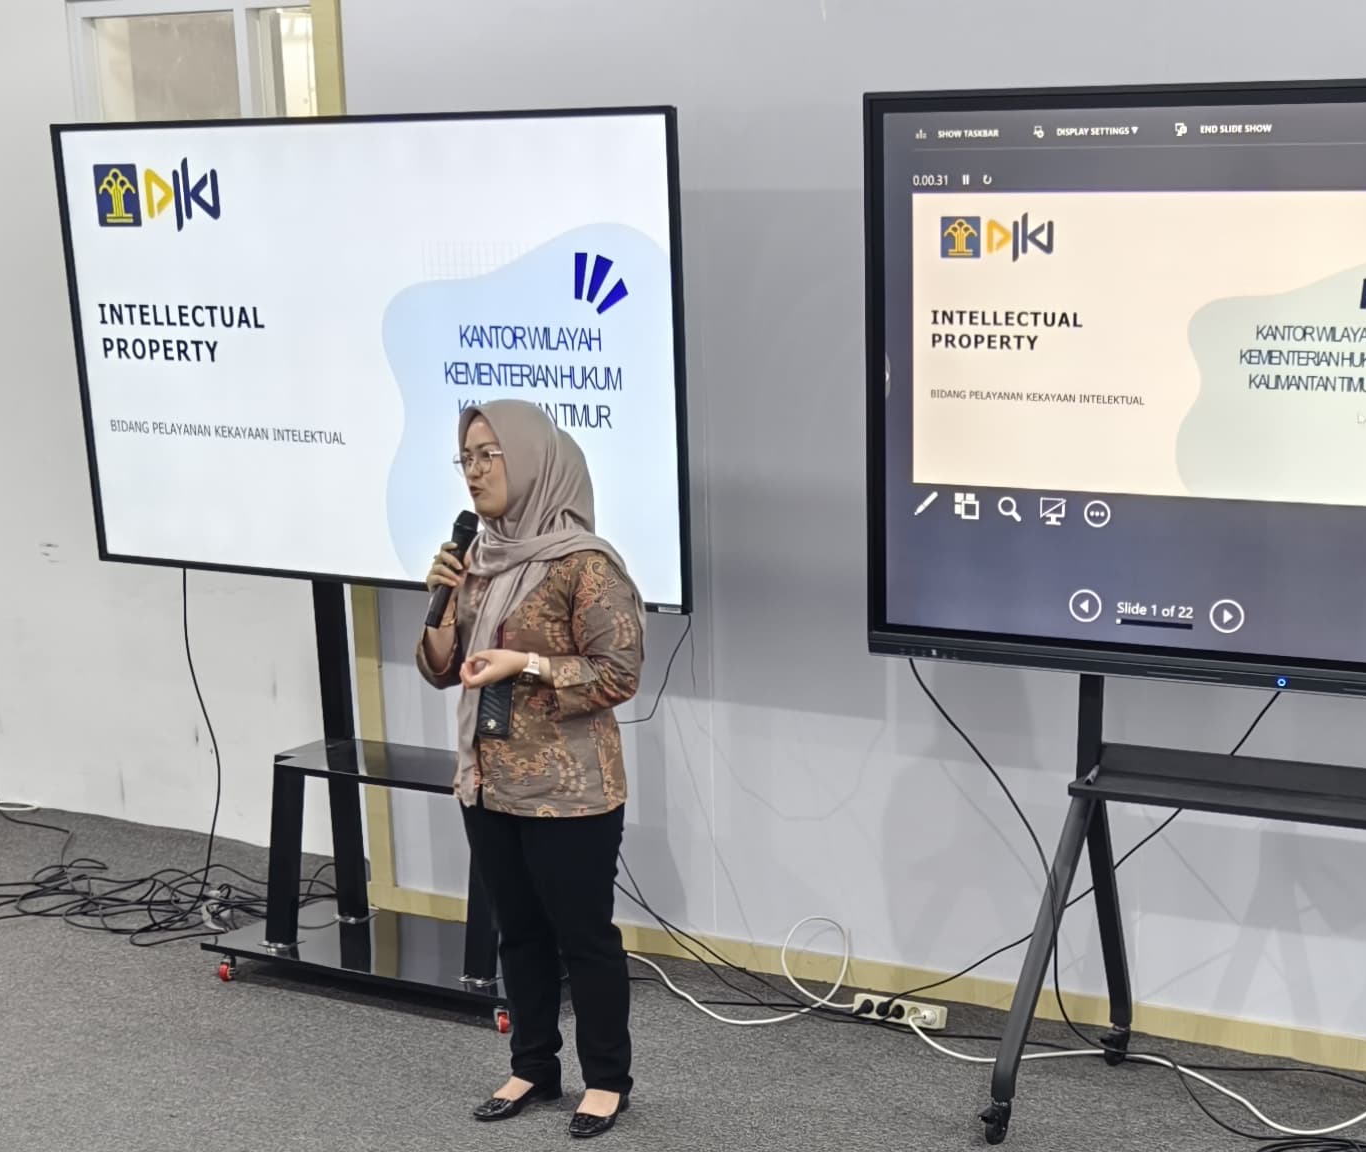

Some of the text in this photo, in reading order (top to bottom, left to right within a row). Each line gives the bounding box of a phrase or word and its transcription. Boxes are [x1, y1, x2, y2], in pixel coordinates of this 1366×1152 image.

[937, 129, 999, 138] SHOW TASKBAR
[1056, 126, 1129, 136] DISPLAY SETTINGS
[1200, 123, 1273, 134] END SLIDE SHOW
[98, 303, 265, 329] INTELLECTUAL
[931, 310, 1083, 328] INTELLECTUAL
[459, 324, 602, 352] KANTOR WILAYAH
[931, 333, 1039, 350] PROPERTY
[1255, 324, 1315, 342] KANTOR
[102, 337, 218, 362] PROPERTY
[1239, 348, 1340, 367] KEMENTERIAN
[444, 361, 623, 392] KEMENTERIAN HUKUM
[1248, 373, 1337, 392] KALIMANTAN
[930, 389, 1145, 406] BIDANG PELAYANAN KEKAYAAN INTELEKTUAL
[559, 402, 613, 429] TIMUR
[110, 419, 346, 445] BIDANG PELAYANAN KEKAYAAN INTELEKTUAL
[1116, 601, 1194, 619] Slide 1 of 22
